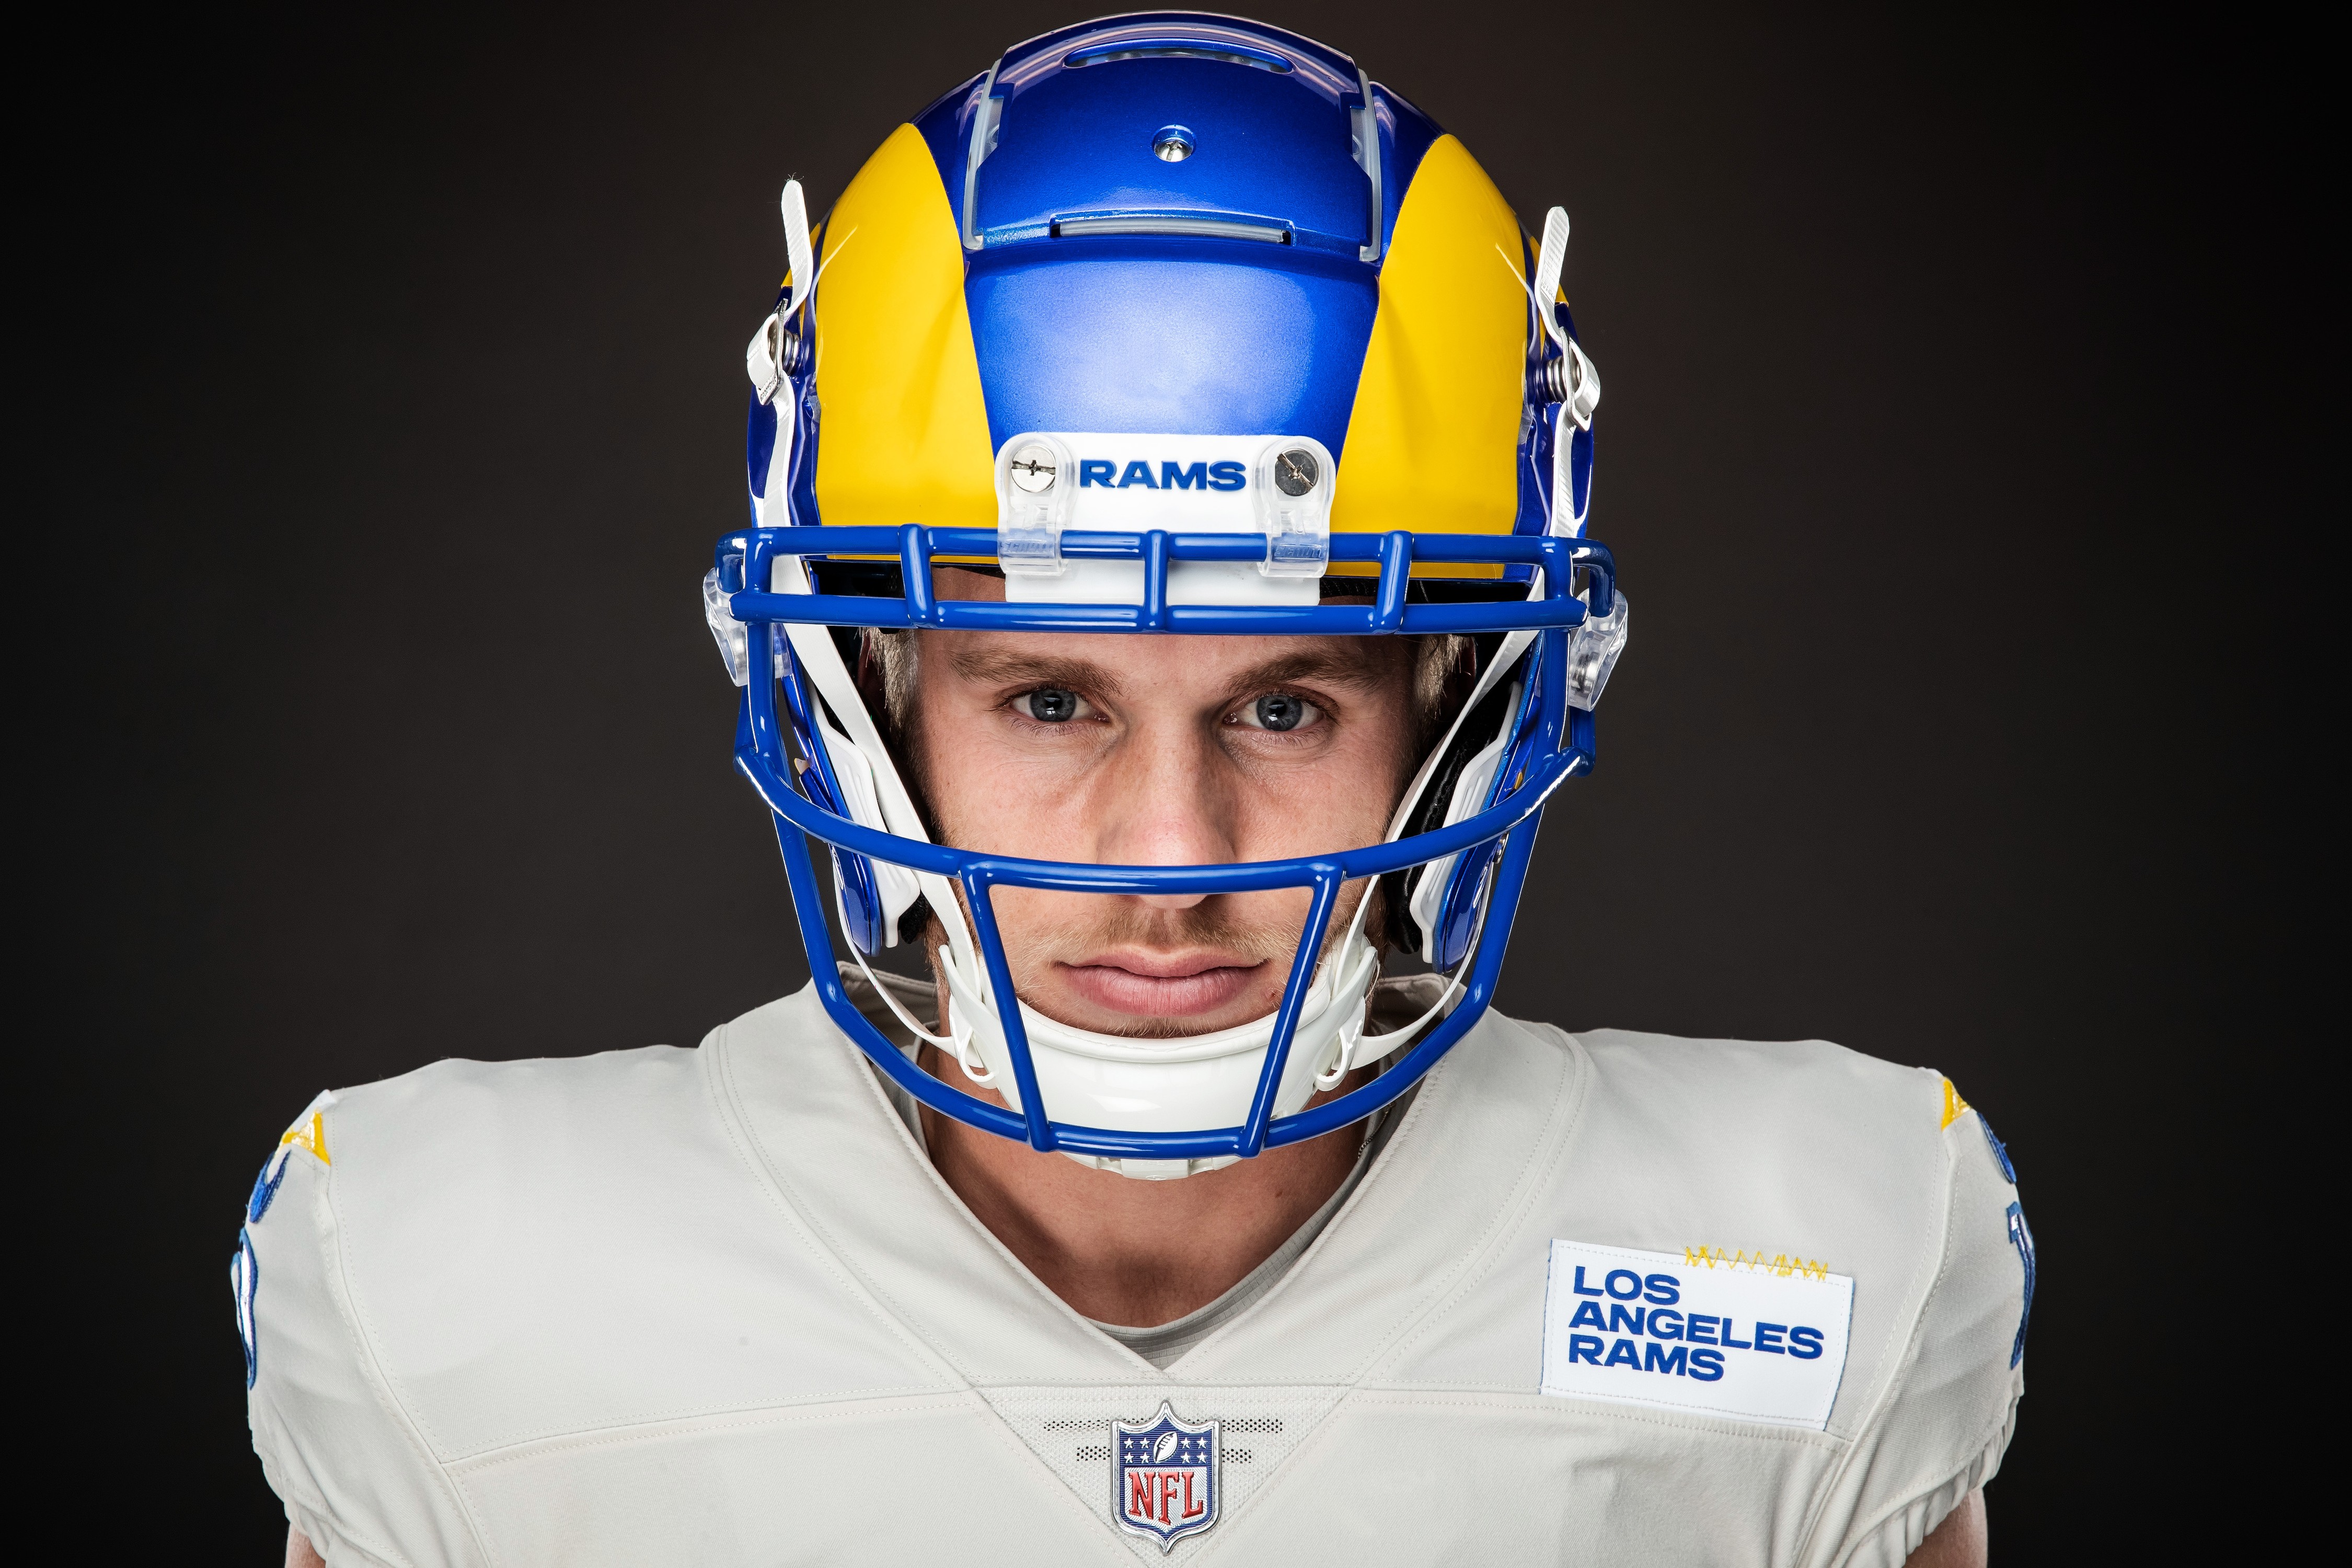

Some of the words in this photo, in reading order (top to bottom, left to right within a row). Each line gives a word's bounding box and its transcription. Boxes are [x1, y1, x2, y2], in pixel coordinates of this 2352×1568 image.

[1079, 459, 1247, 492] RAMS
[1573, 1265, 1680, 1306] LOS
[1569, 1300, 1824, 1359] ANGELES
[1569, 1333, 1725, 1381] RAMS
[1128, 1471, 1203, 1526] NFL
